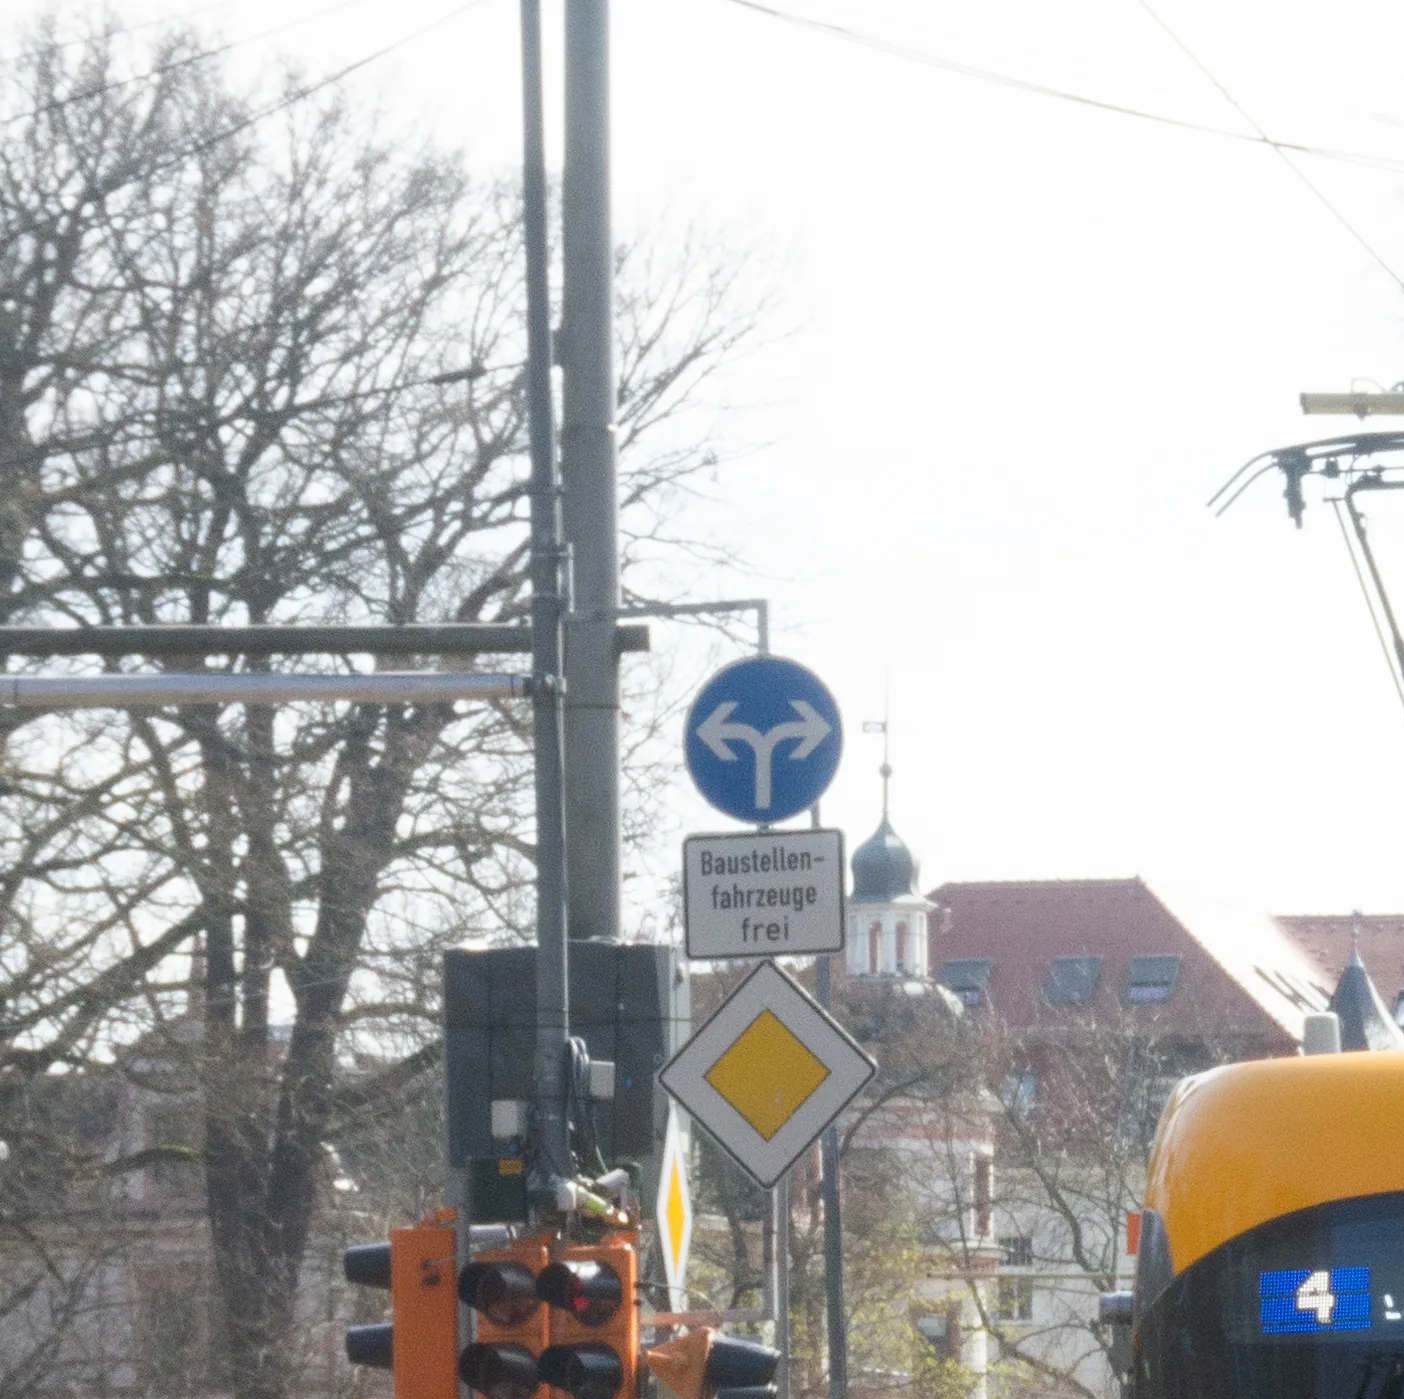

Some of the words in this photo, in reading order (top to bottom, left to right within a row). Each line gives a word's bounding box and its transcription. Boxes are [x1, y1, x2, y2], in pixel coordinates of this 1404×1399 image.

[700, 846, 826, 876] Baustellen-
[711, 883, 818, 912] fahrzeuge
[741, 915, 790, 942] frei
[1296, 1270, 1335, 1324] 4
